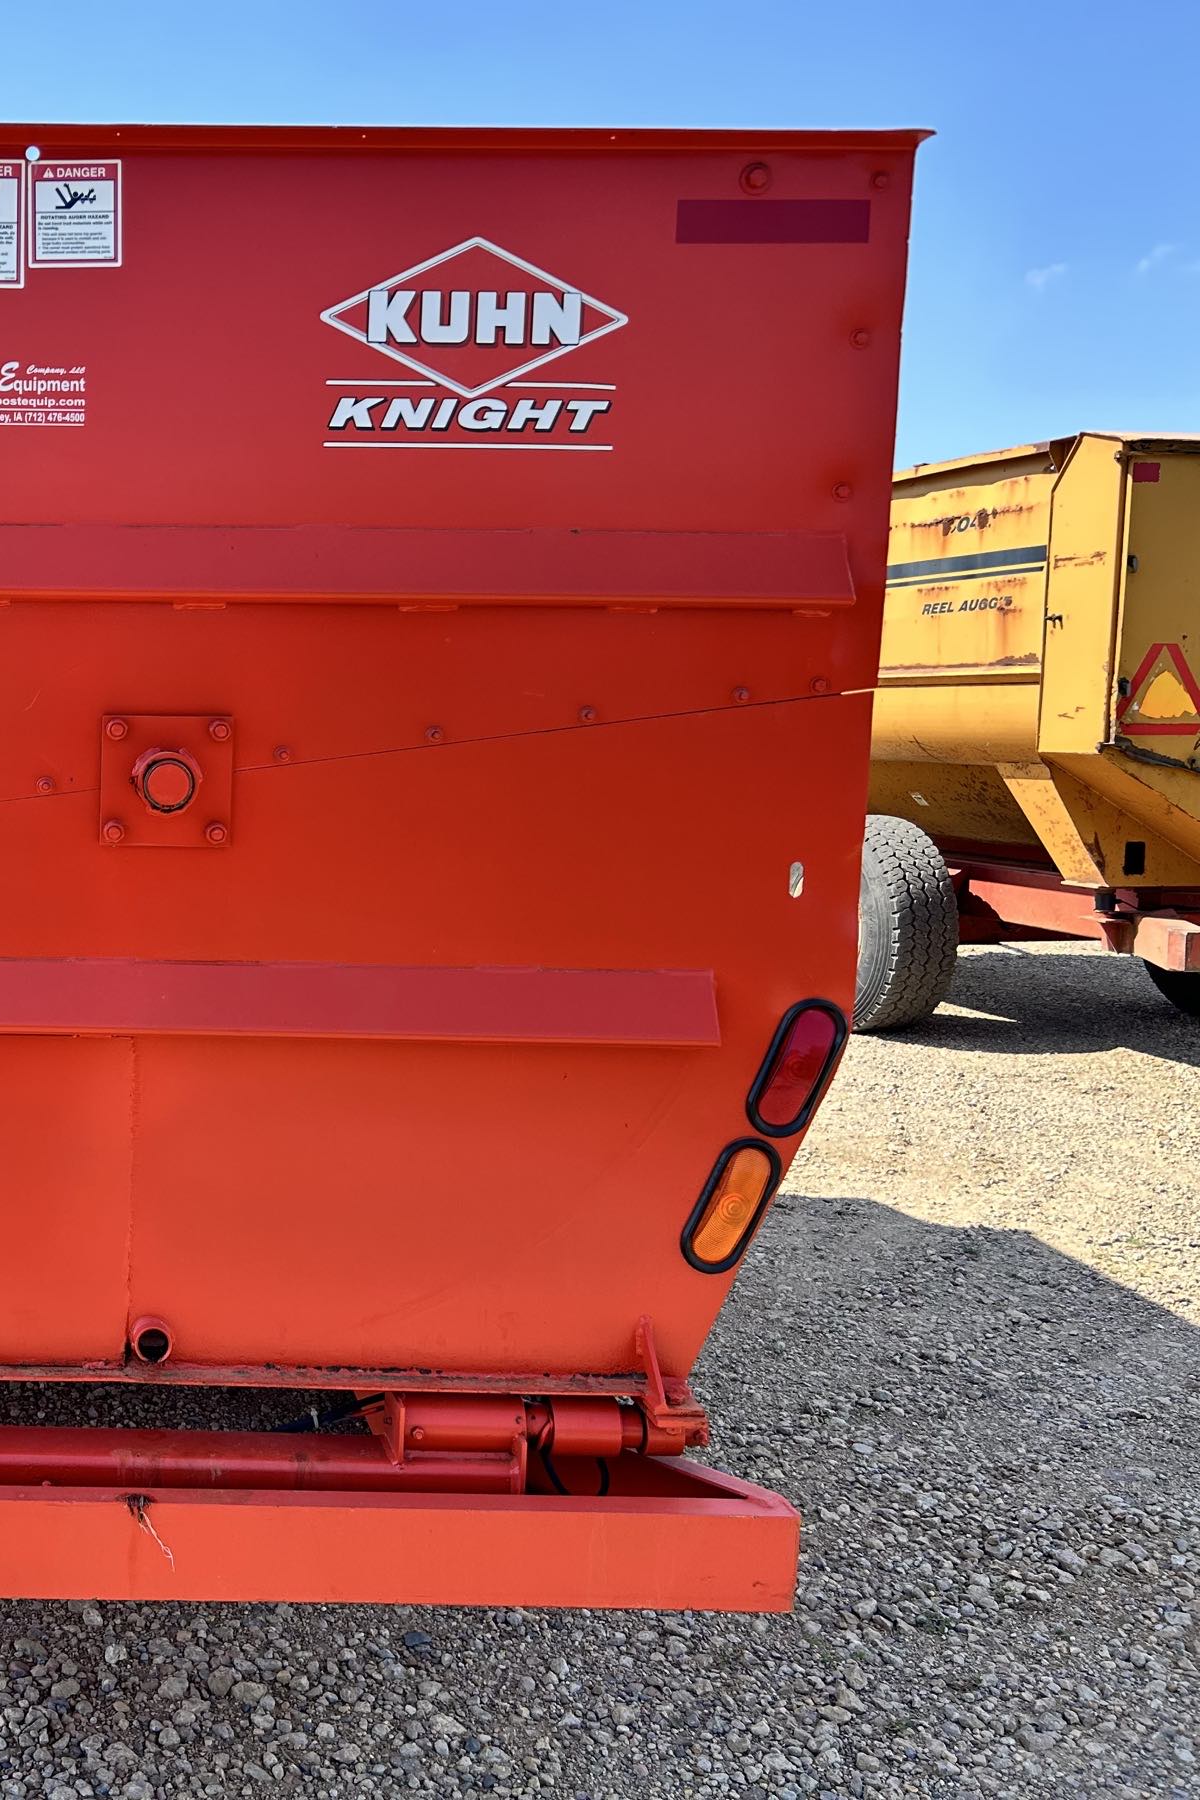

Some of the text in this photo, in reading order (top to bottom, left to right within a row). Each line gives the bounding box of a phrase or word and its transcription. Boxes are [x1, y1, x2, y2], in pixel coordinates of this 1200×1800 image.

[57, 167, 106, 178] DANGER
[366, 290, 582, 346] KUHN
[26, 364, 67, 376] Company,
[13, 413, 22, 421] IA
[24, 413, 45, 423] (712)
[47, 413, 85, 422] 476-4500
[328, 397, 612, 432] KNIGHT
[921, 601, 954, 615] REEL
